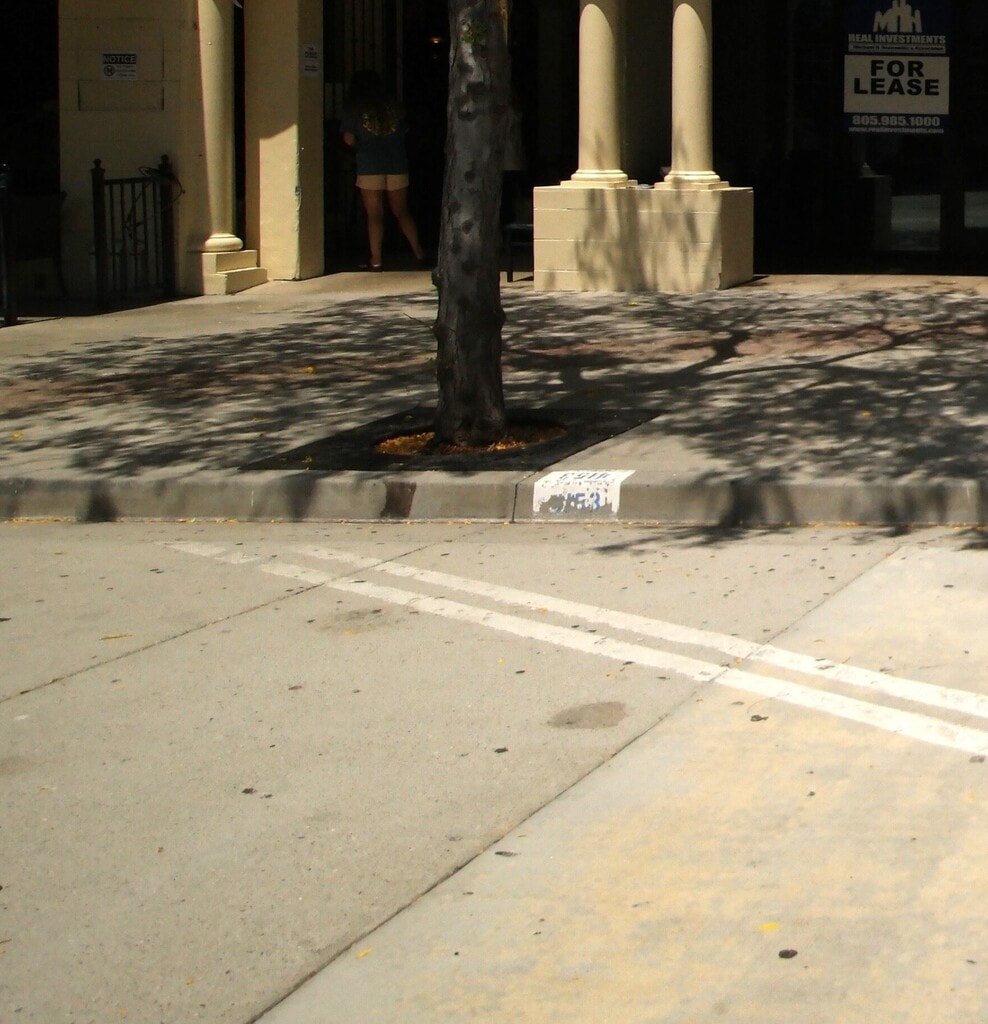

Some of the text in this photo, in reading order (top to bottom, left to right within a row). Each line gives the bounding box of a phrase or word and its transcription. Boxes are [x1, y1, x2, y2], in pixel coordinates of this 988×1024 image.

[848, 33, 946, 44] REAL INVESTMENTS
[103, 55, 137, 64] NOTICE
[870, 60, 924, 77] FOR
[853, 78, 940, 96] LEASE
[852, 115, 940, 127] 805.985.1000
